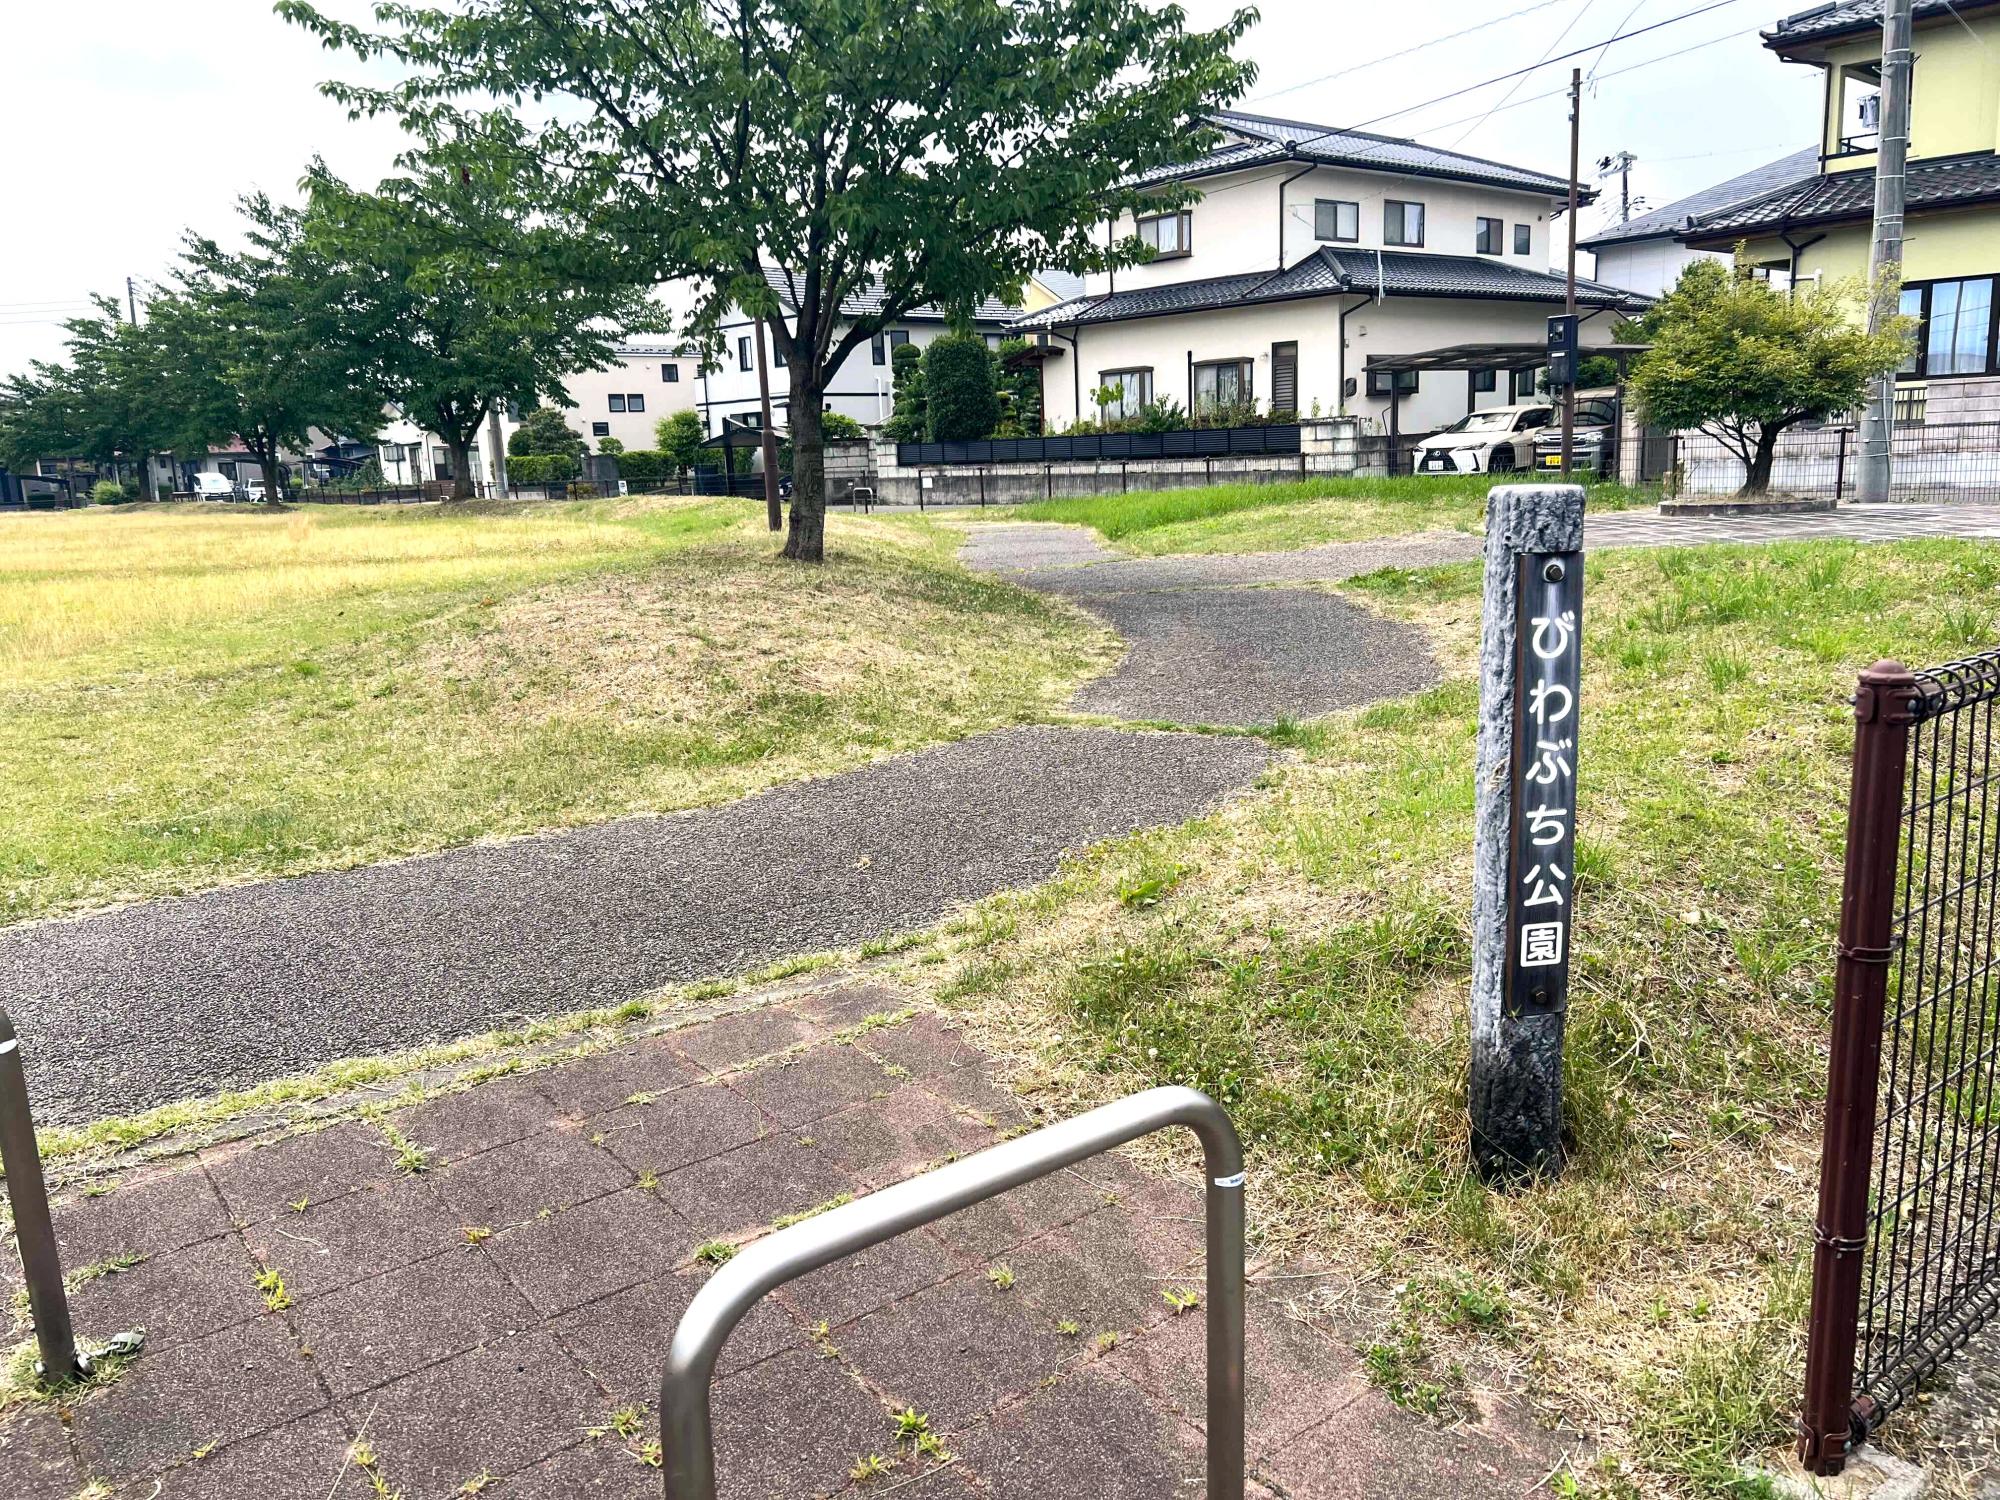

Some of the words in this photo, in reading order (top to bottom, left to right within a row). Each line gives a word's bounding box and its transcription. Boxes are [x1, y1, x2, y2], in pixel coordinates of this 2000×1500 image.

[1520, 611, 1575, 967] びわぶち公園
